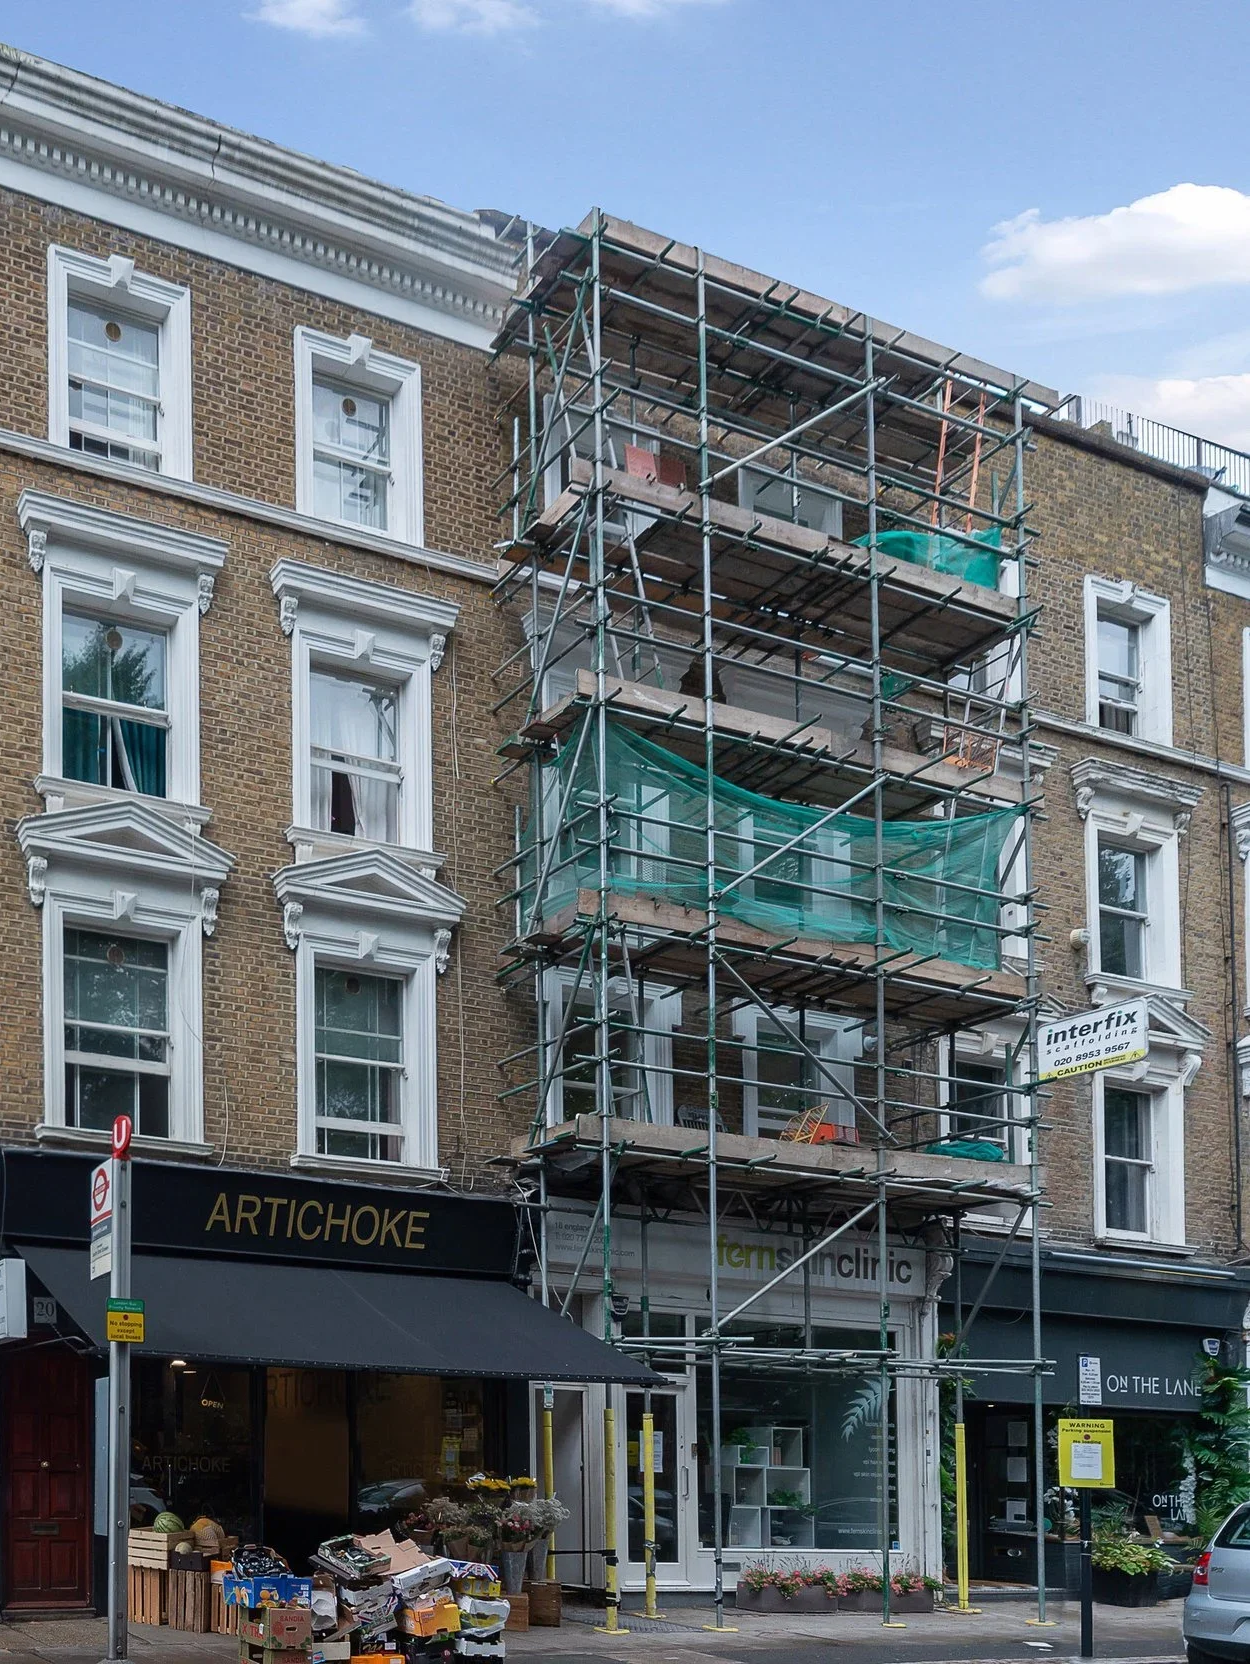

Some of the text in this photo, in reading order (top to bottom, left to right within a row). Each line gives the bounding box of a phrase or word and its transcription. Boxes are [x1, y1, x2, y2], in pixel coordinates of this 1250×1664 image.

[1046, 1010, 1138, 1046] interfix
[1046, 1026, 1138, 1055] scaffolding
[1053, 1056, 1073, 1067] 020
[1075, 1049, 1101, 1062] 8953
[1104, 1041, 1130, 1054] 9567
[1057, 1060, 1103, 1076] CAUTION
[113, 1119, 127, 1149] U
[204, 1192, 431, 1250] ARTICHOKE
[35, 1301, 55, 1317] 20
[1106, 1374, 1128, 1393] ON
[1132, 1376, 1160, 1394] THE
[1165, 1377, 1202, 1397] LANE
[201, 1398, 224, 1409] OPEN
[141, 1455, 231, 1473] ARTICHOKE
[1152, 1494, 1168, 1508] ON
